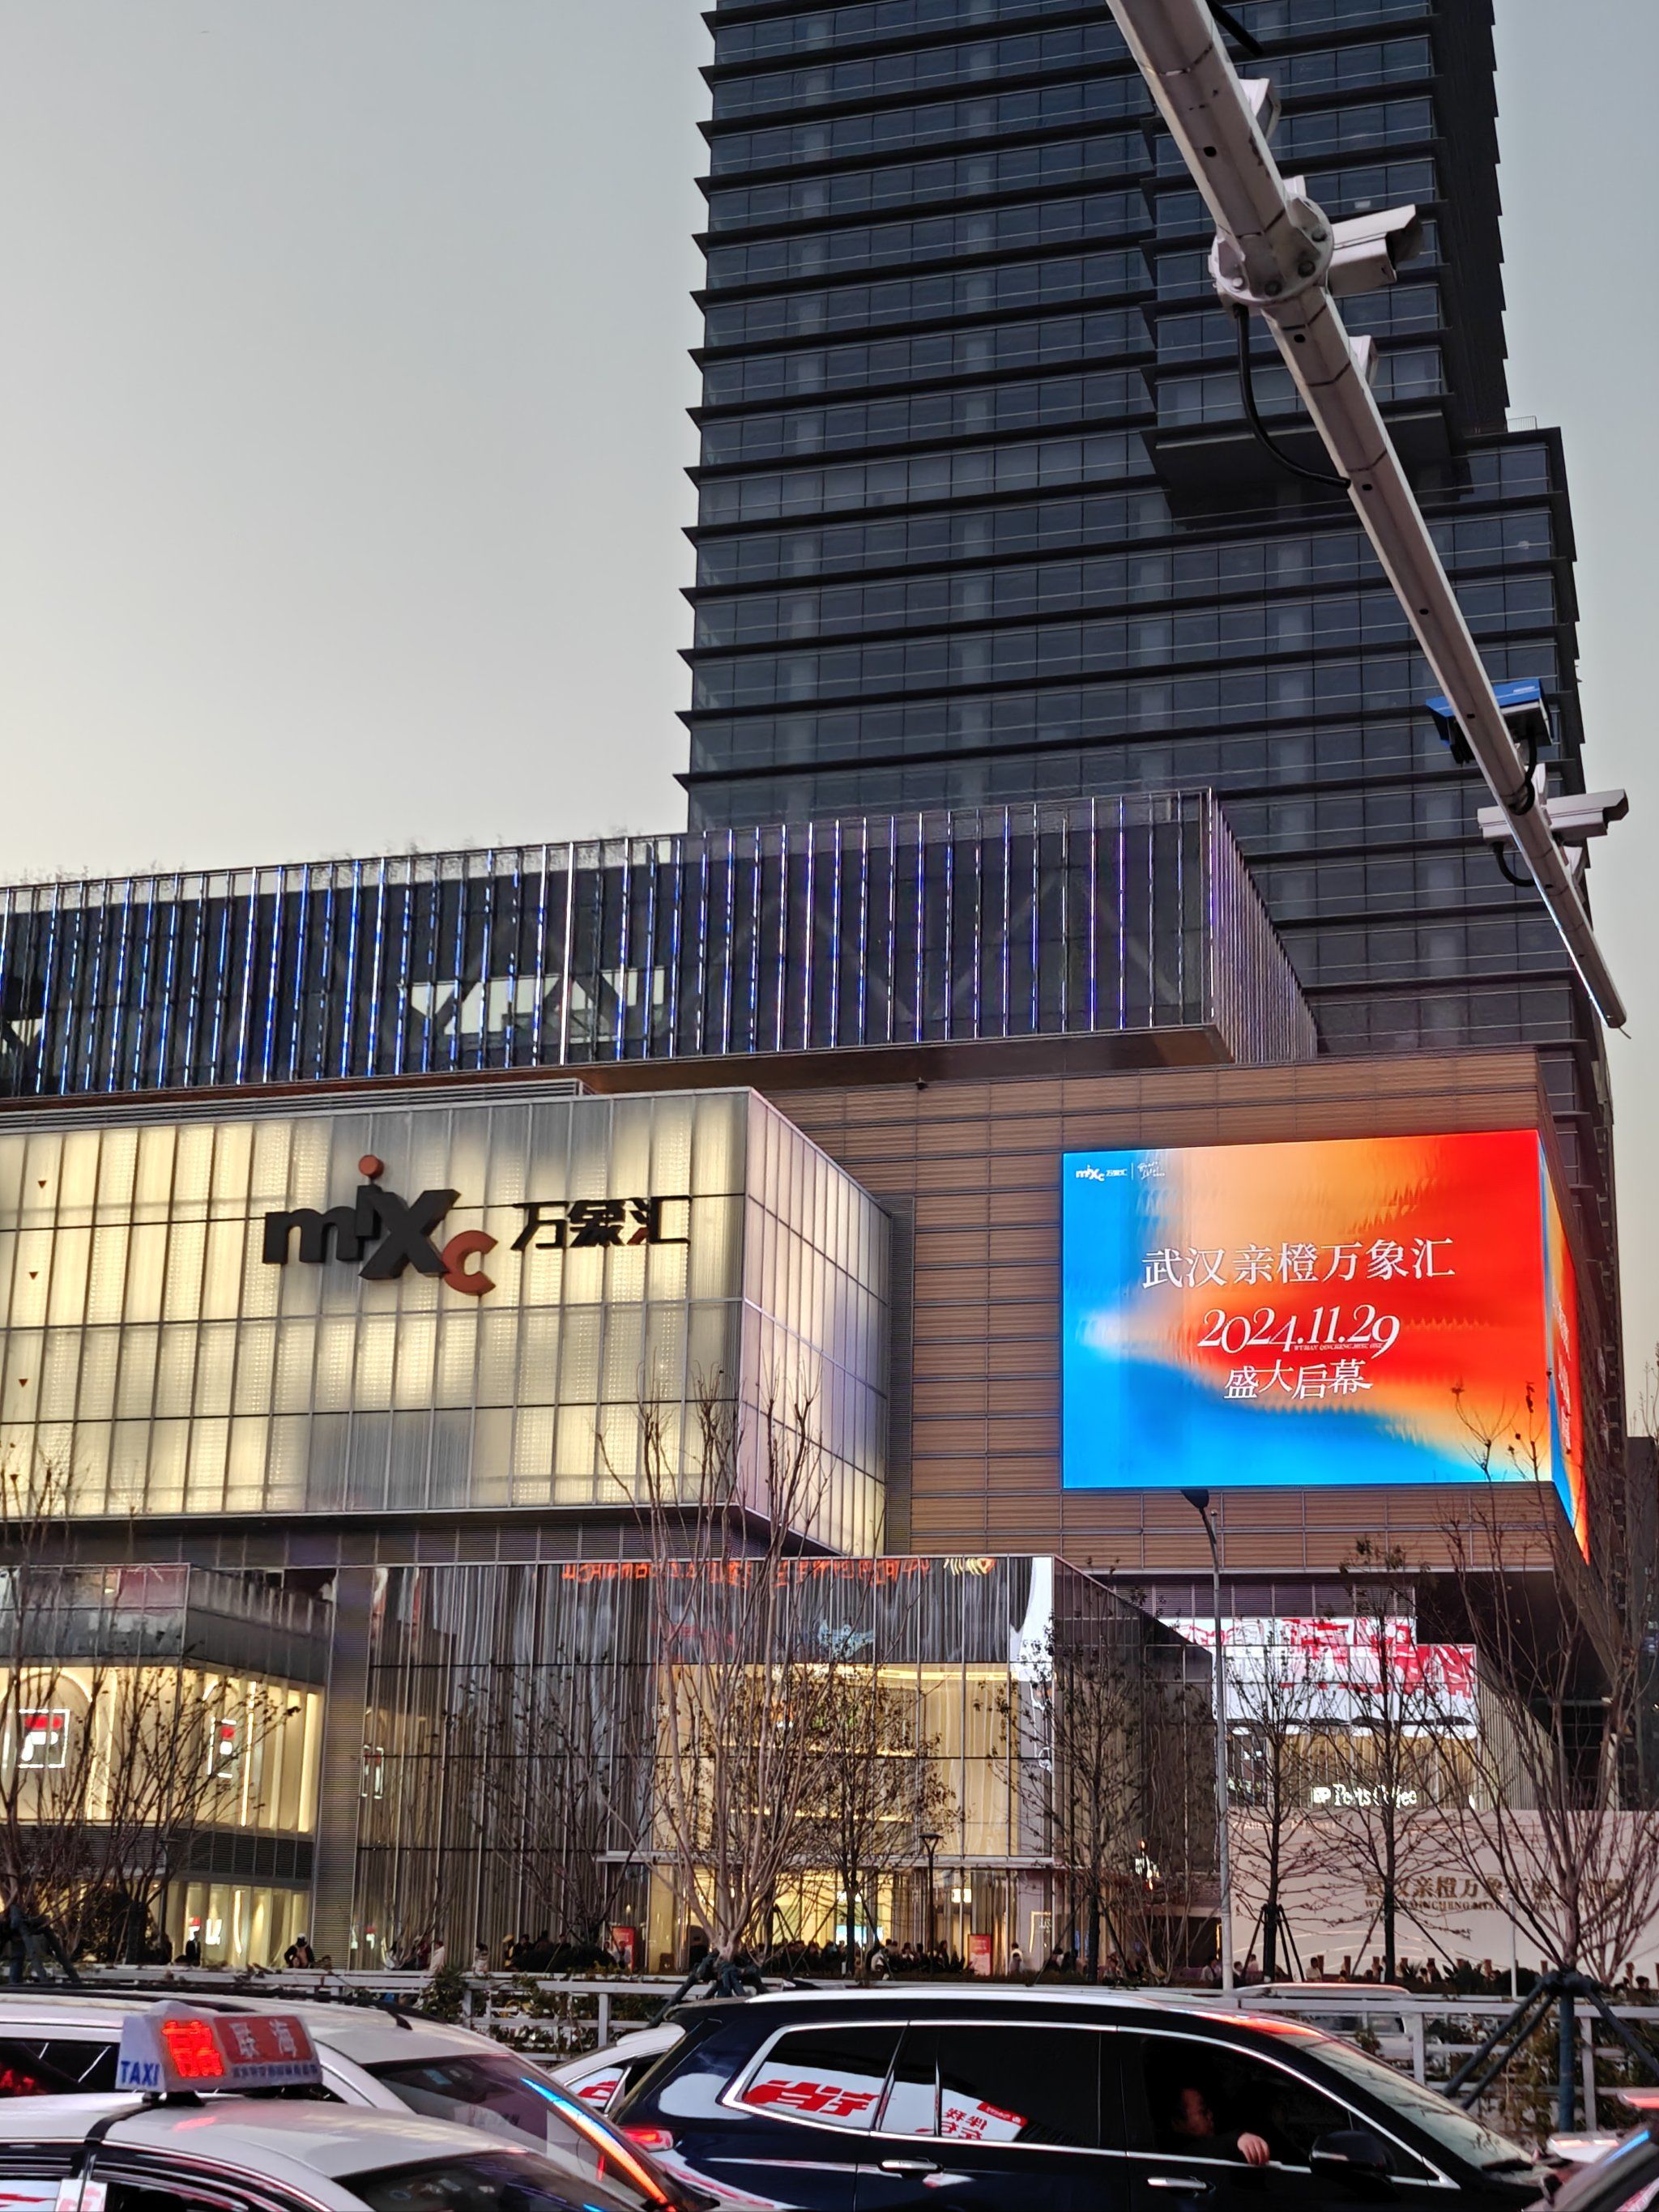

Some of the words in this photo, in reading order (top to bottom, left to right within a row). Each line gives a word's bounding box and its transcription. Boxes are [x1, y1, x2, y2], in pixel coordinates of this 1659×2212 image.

[510, 1195, 693, 1251] 万象汇
[1141, 1238, 1456, 1289] 武汉亲橙万象汇
[1196, 1303, 1401, 1360] 2024.11.29
[1223, 1358, 1374, 1400] 盛大启幕
[121, 2061, 160, 2087] TAXI
